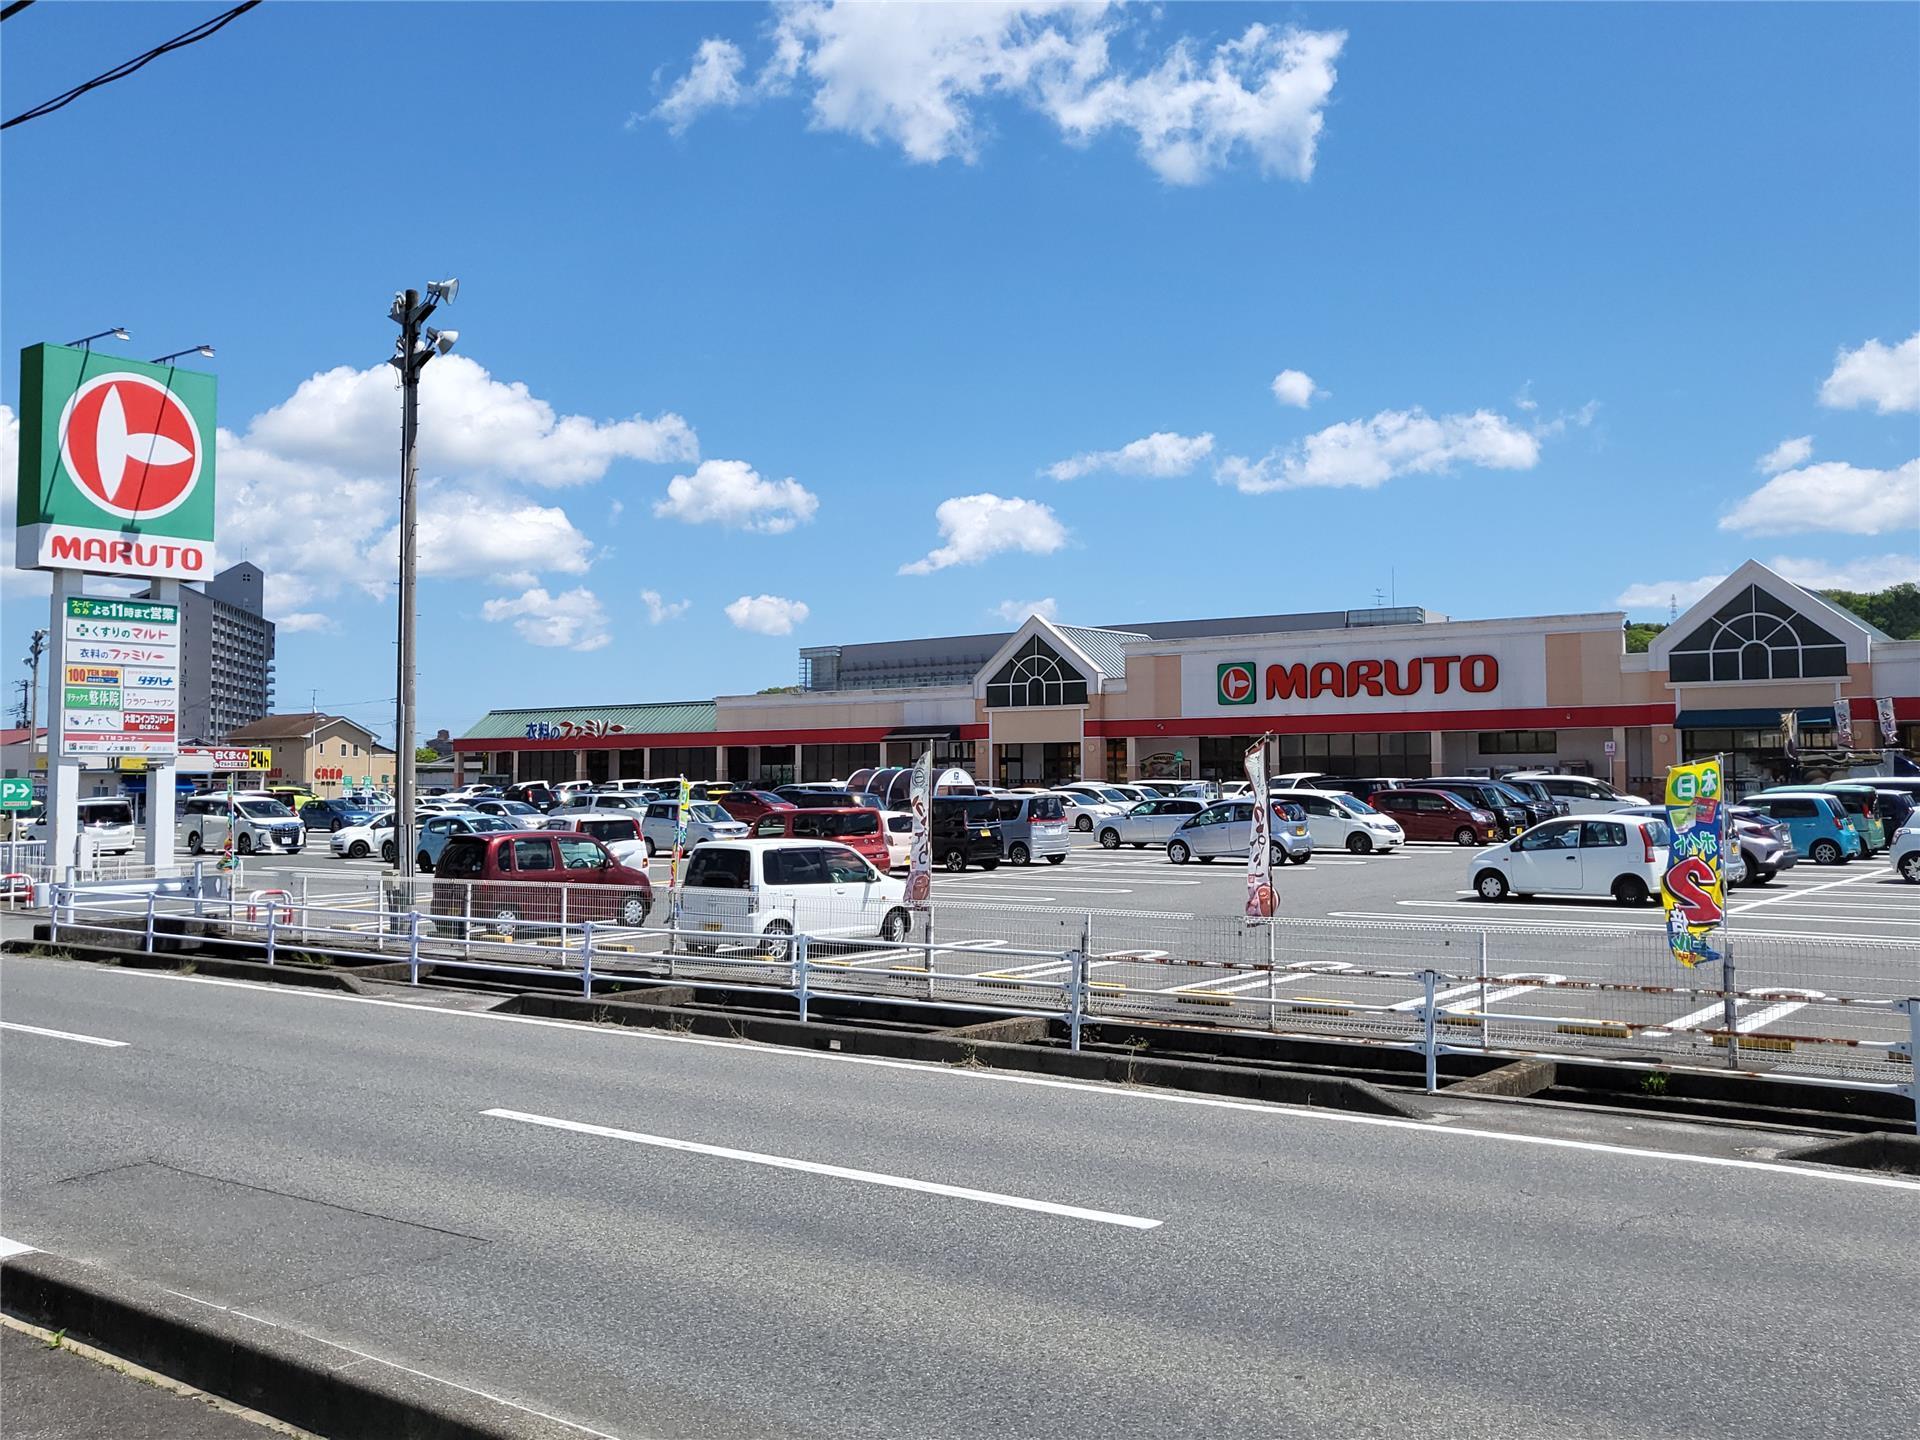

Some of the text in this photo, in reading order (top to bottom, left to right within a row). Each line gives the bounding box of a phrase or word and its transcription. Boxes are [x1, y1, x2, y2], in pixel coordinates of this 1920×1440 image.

[51, 535, 203, 571] MARUTO
[92, 603, 175, 621] よる11時まで営業
[92, 626, 169, 640] くすりのマルト
[80, 648, 165, 661] 衣料のファミリー
[68, 668, 86, 682] 100
[1265, 654, 1499, 700] MARUTO
[525, 718, 626, 742] 衣料のファミリー
[215, 750, 249, 760] 白くまくん
[250, 751, 270, 768] 24h
[3, 783, 16, 798] P
